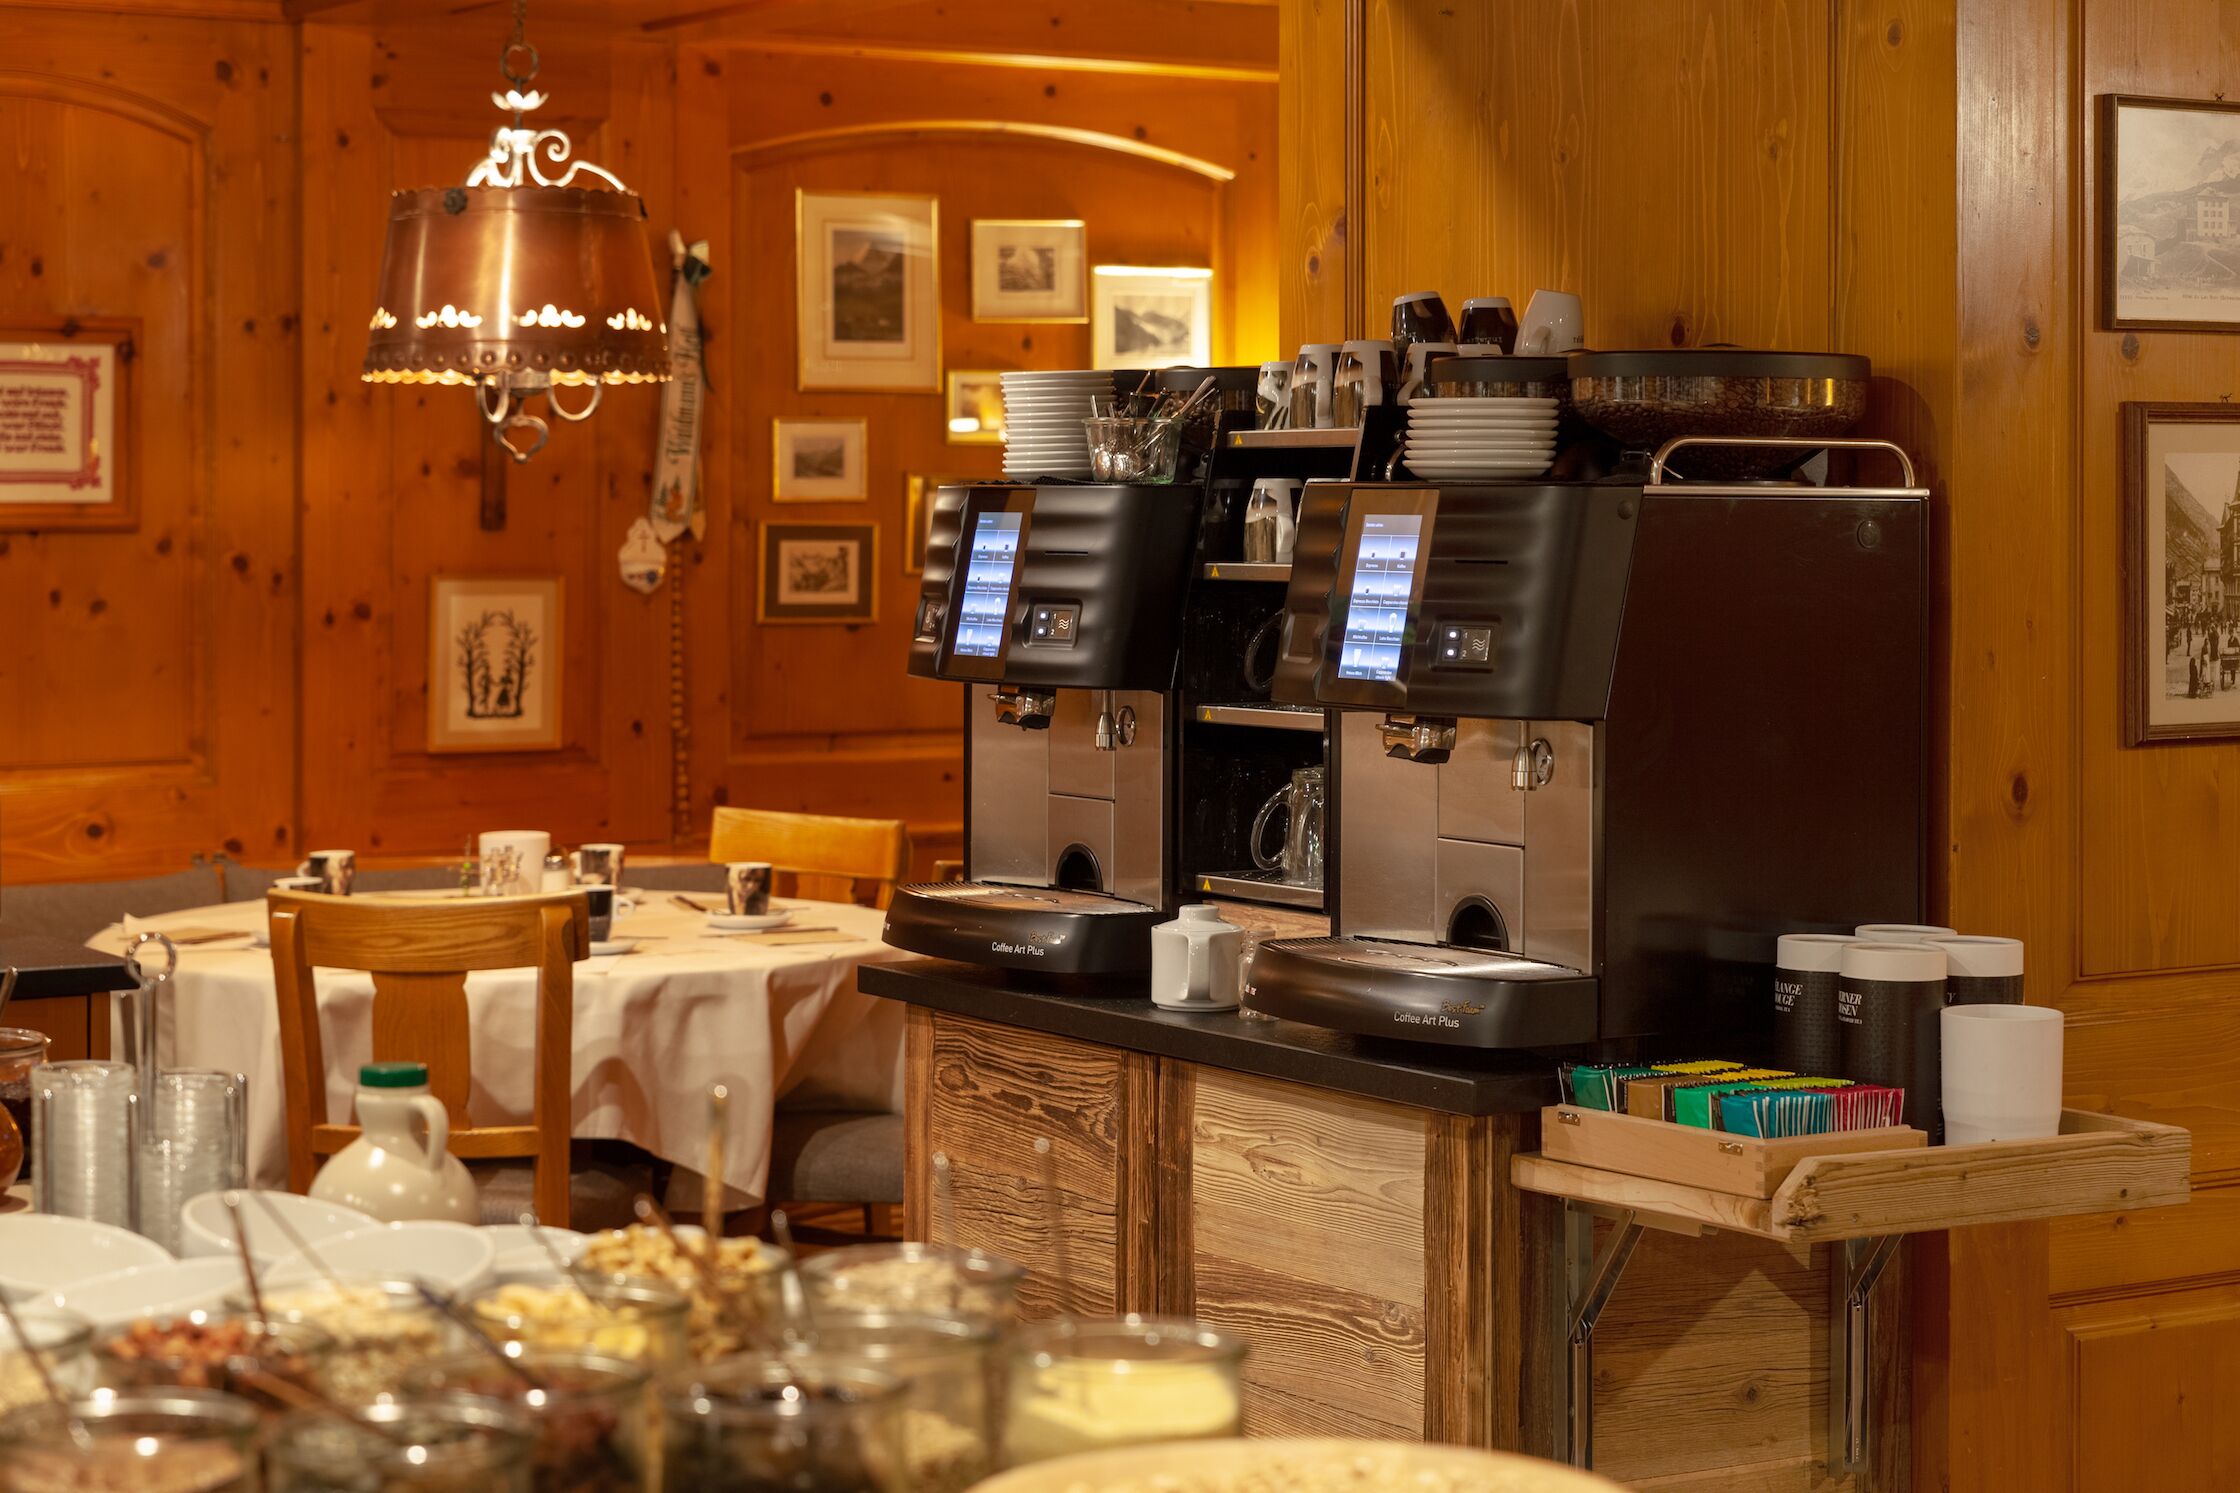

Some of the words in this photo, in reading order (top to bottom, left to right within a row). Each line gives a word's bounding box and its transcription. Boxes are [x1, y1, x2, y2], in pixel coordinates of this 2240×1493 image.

[991, 941, 1014, 953] Coffee
[1014, 944, 1026, 955] Art
[1027, 945, 1045, 956] Plus
[1393, 1010, 1421, 1024] Coffee
[1422, 1014, 1437, 1026] Art
[1438, 1015, 1460, 1028] Plus
